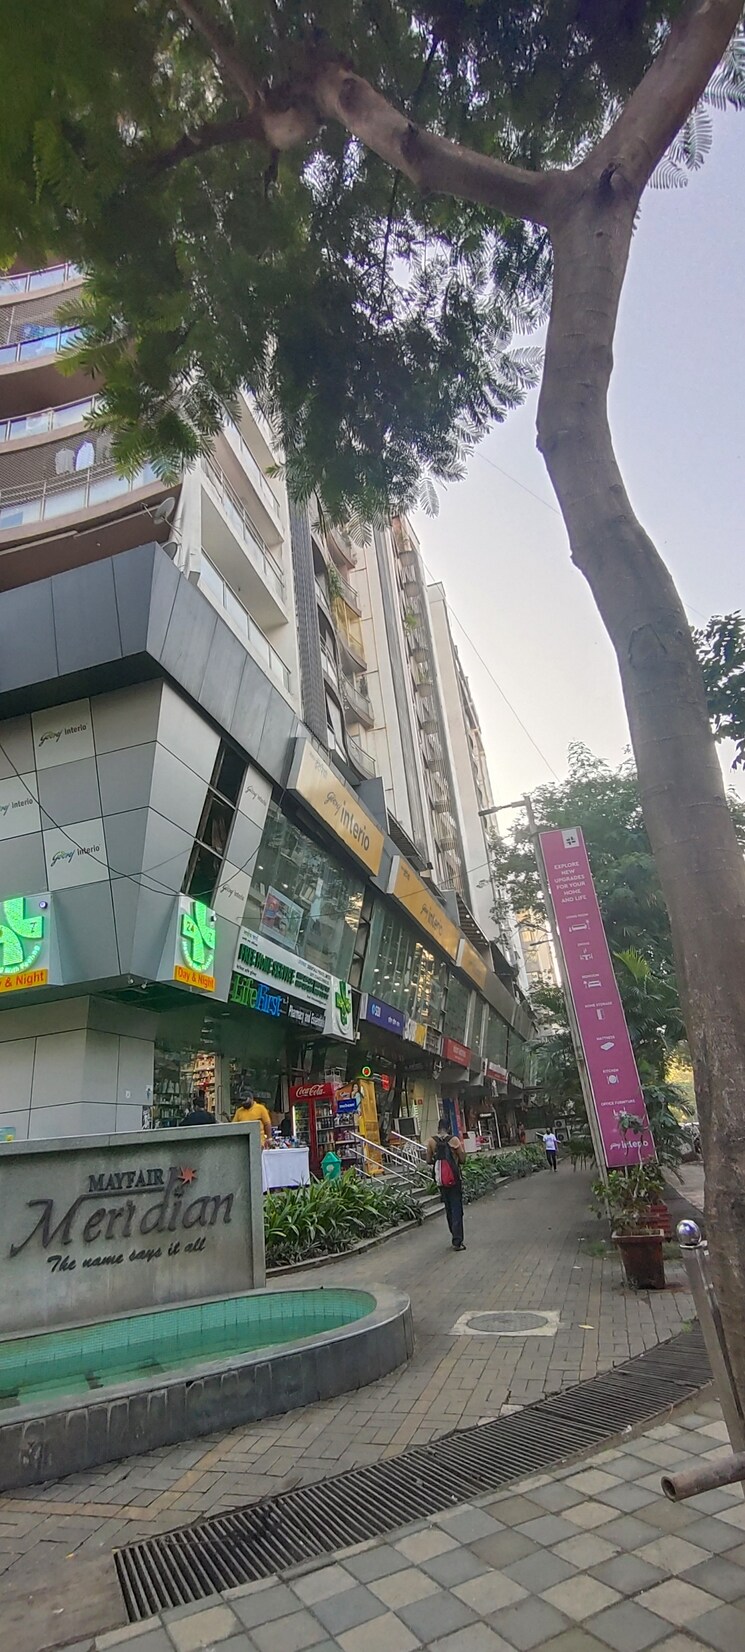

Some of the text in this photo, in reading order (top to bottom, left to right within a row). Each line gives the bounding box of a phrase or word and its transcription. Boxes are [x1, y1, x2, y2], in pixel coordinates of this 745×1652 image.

[340, 800, 370, 851] interio
[554, 861, 580, 870] EXPLORE
[561, 868, 576, 876] NEW
[554, 874, 586, 884] UPGRADES
[556, 881, 586, 891] FOR YOUR
[563, 888, 582, 896] HOME
[561, 896, 574, 904] AND
[5, 977, 13, 988] &
[16, 972, 44, 985] Night
[177, 966, 214, 989] Day & Night
[88, 1168, 165, 1193] MAYFAIR
[9, 1167, 235, 1259] Meridian
[47, 1236, 206, 1273] The name says it all
